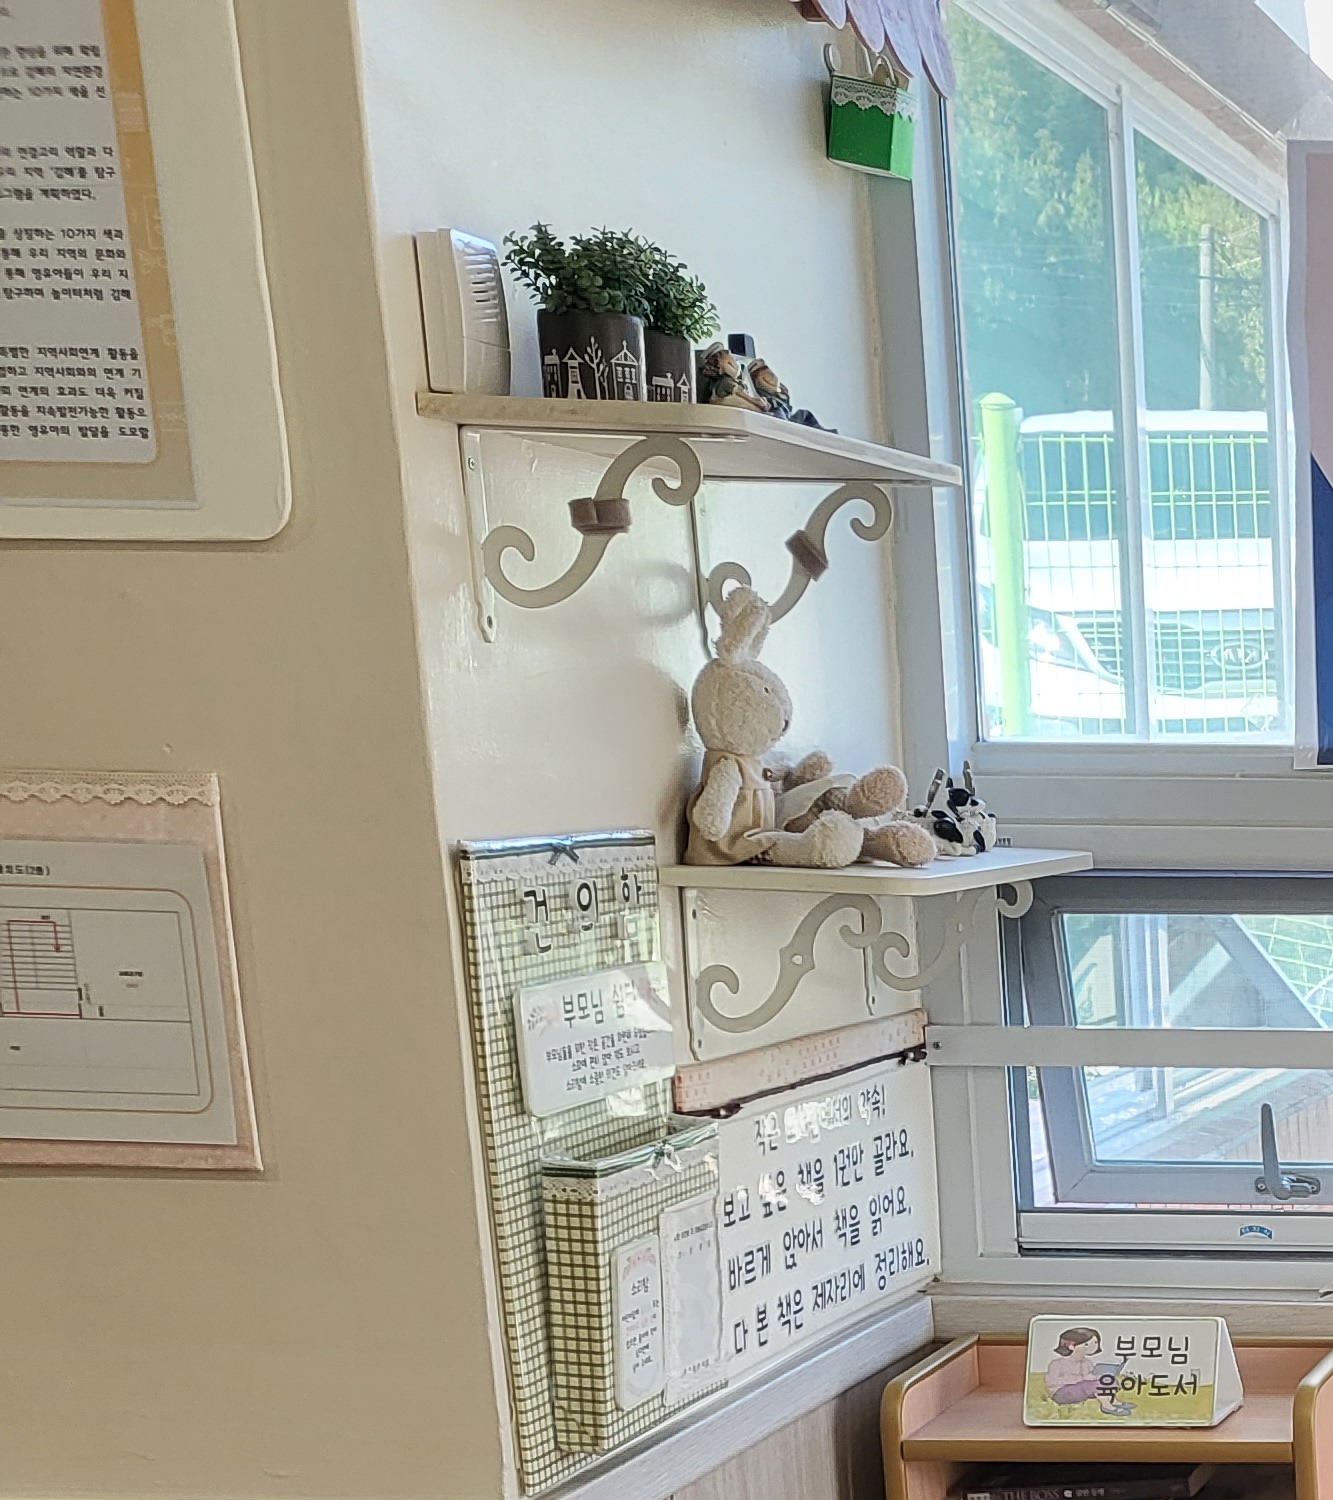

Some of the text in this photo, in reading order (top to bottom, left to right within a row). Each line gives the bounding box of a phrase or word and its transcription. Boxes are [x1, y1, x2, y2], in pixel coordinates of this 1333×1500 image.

[60, 228, 97, 239] 10가지
[91, 268, 112, 279] 우리
[562, 988, 605, 1029] 부모님
[723, 1188, 751, 1229] 보고
[873, 1128, 915, 1177] 골라요.
[728, 1186, 913, 1291] 바르게 앉아서 책을 읽어요.
[734, 1237, 931, 1355] 다 본 책은 제자리에 정리해요.
[1115, 1336, 1189, 1365] 부모님
[1096, 1374, 1198, 1404] 육아도서
